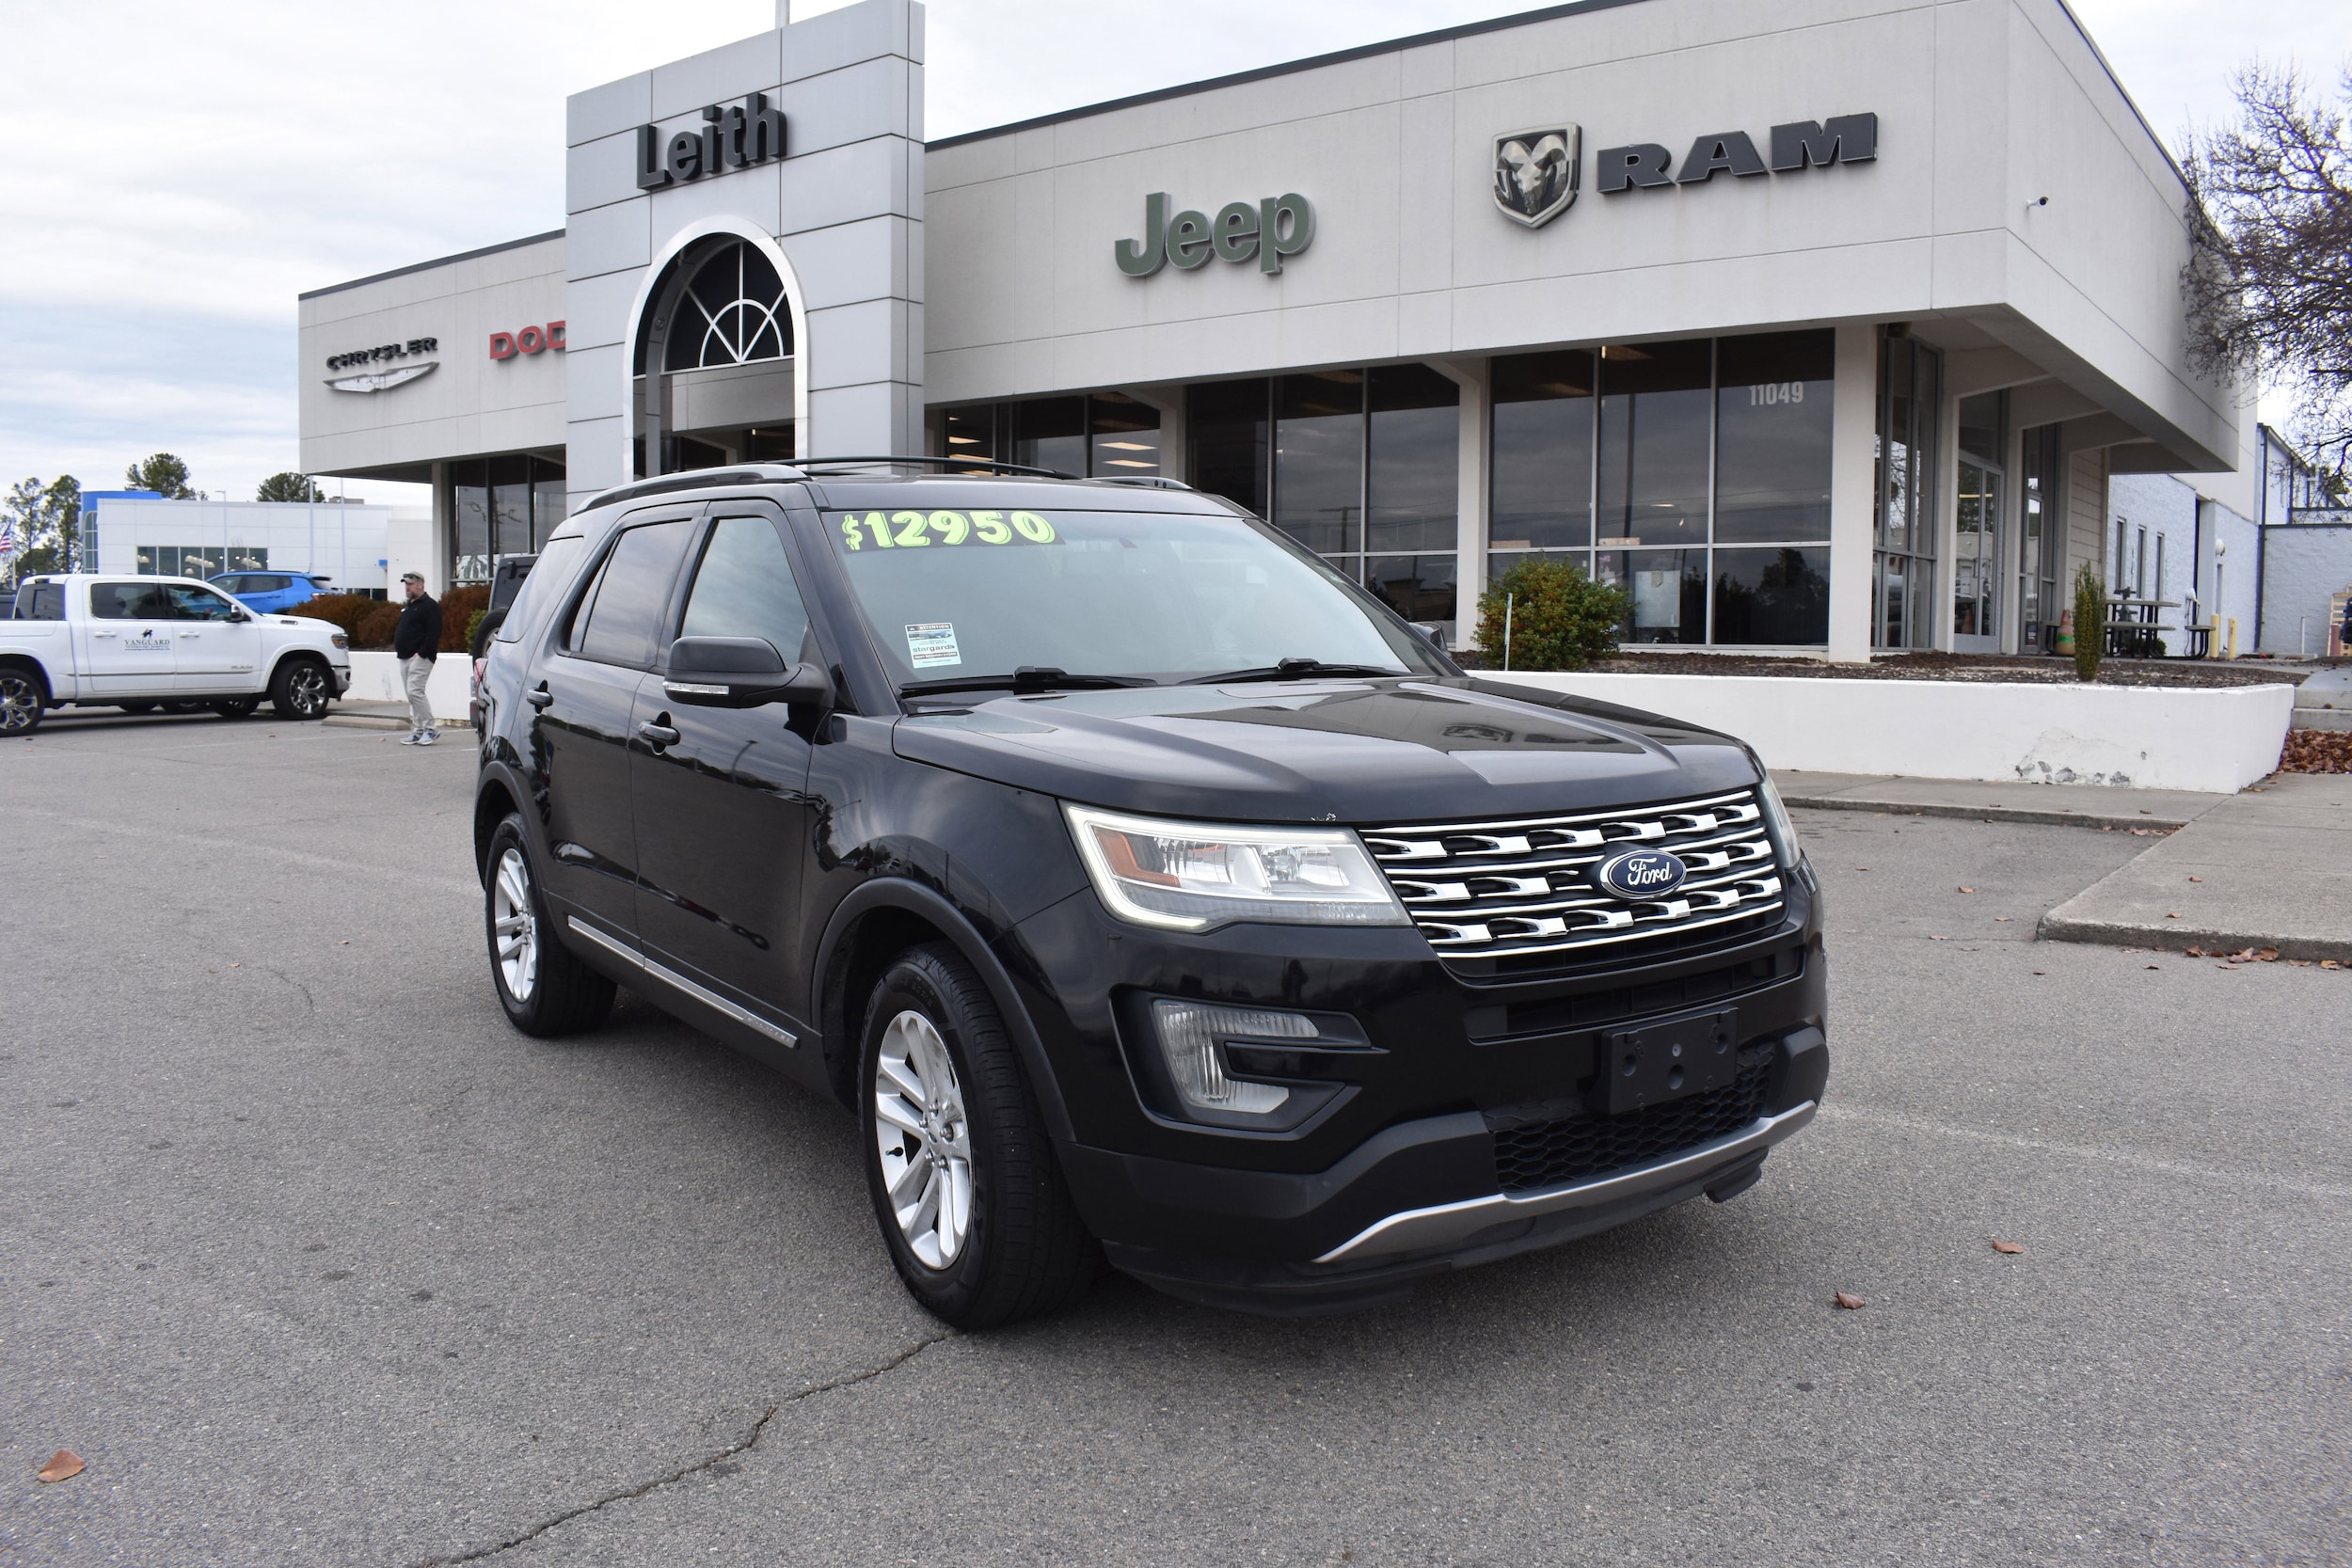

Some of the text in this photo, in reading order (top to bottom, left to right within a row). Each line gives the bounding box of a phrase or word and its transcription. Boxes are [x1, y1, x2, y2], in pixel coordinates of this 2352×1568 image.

[637, 92, 787, 189] Leith
[1597, 112, 1878, 194] RAM
[1115, 192, 1316, 277] Jeep
[326, 337, 438, 370] CHRYSLER
[1749, 381, 1804, 406] 11049
[842, 510, 1056, 551] $12950
[1627, 857, 1673, 886] Ford
